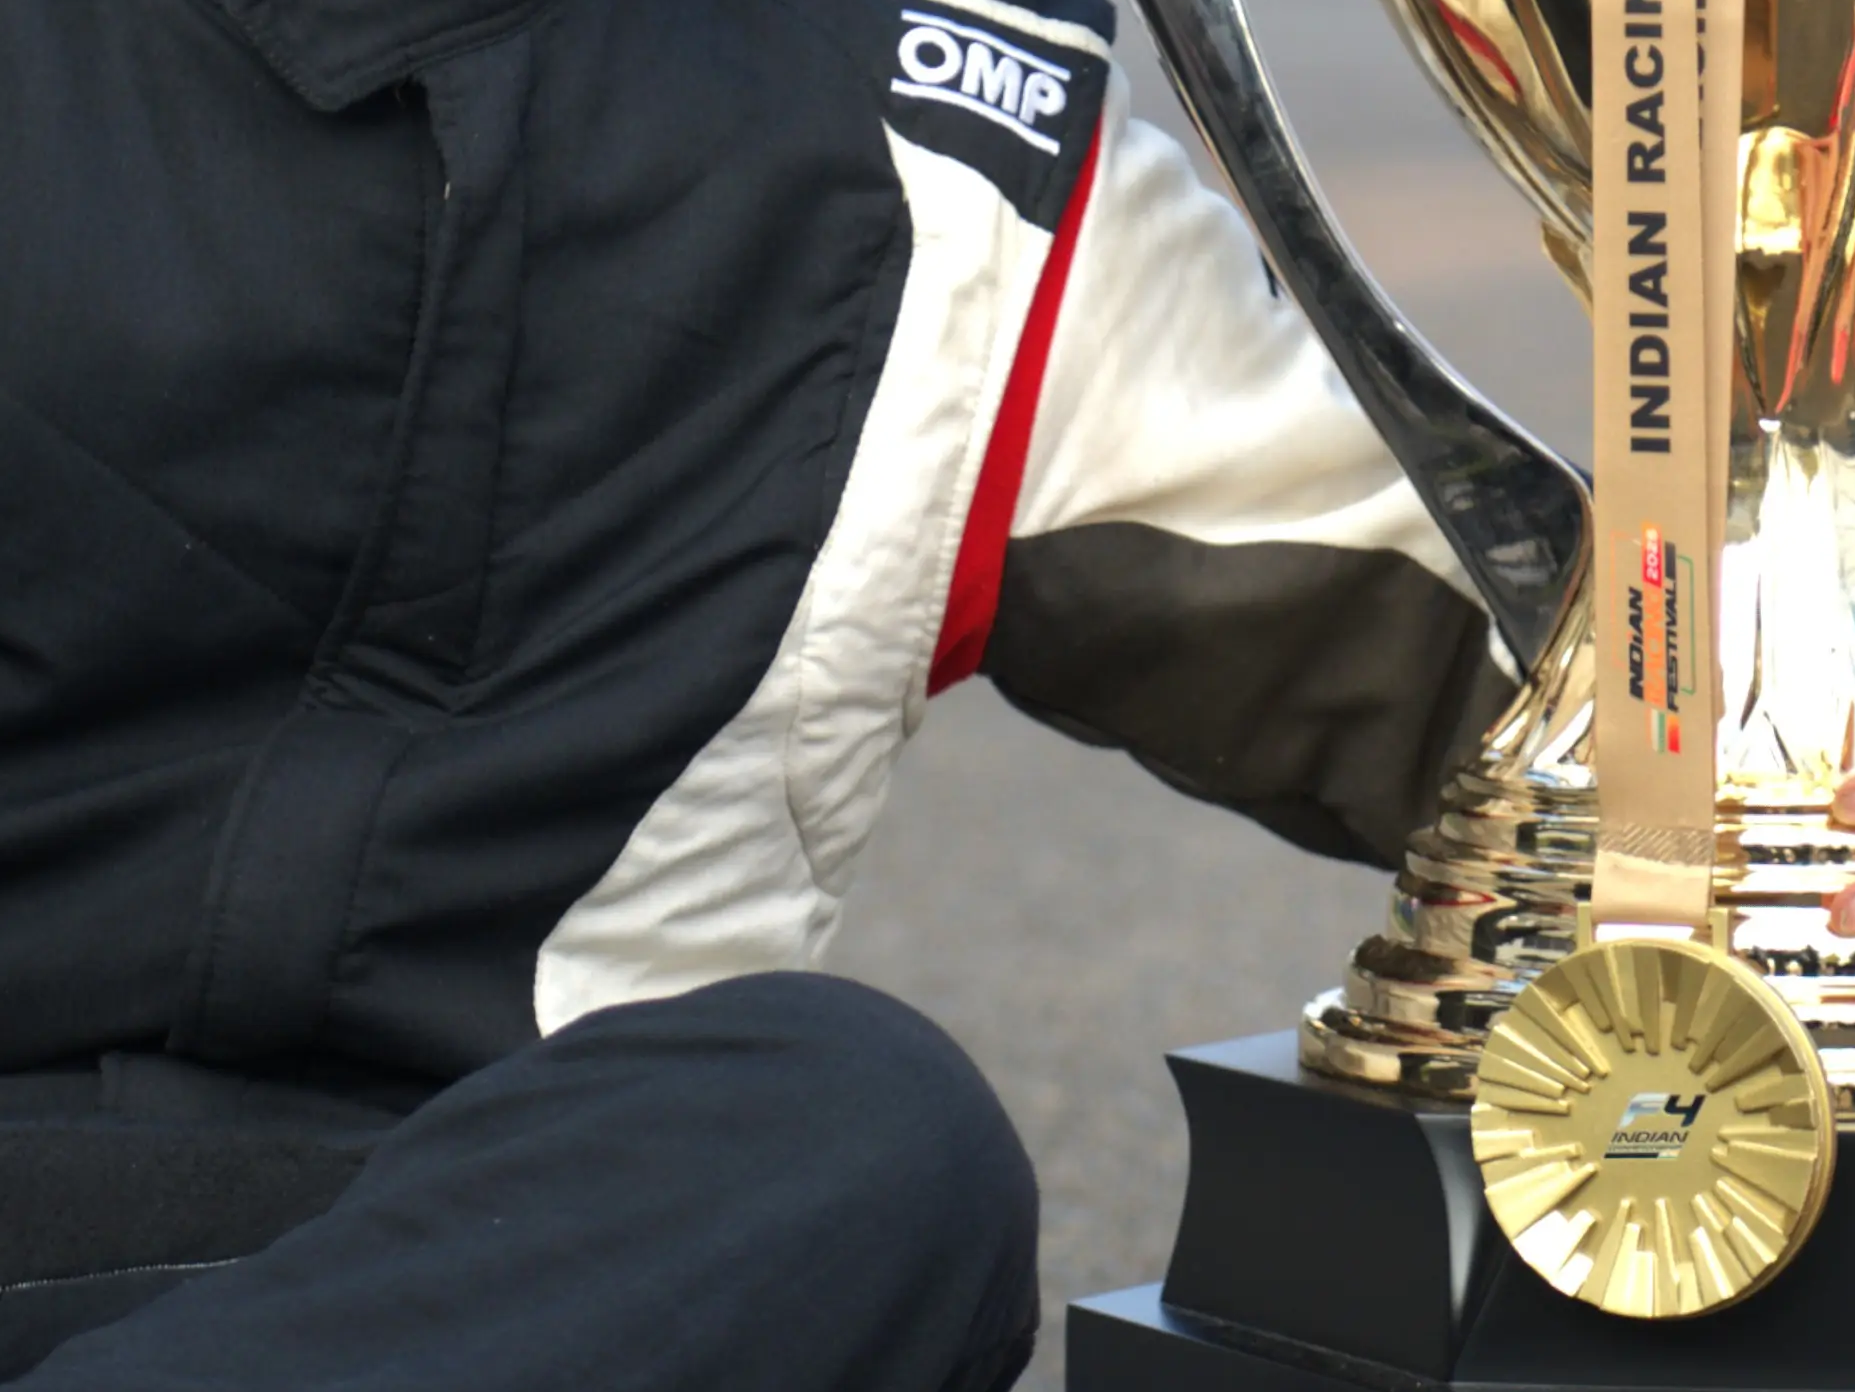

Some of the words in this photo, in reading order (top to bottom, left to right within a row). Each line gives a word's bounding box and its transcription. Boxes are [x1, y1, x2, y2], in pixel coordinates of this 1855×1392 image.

[898, 26, 1067, 125] OMP
[1627, 210, 1672, 454] INDIAN
[1646, 527, 1659, 582] 2025
[1665, 576, 1680, 713] FESTIVAL
[1611, 1130, 1690, 1143] INDIAN
[1618, 1092, 1706, 1128] F4
